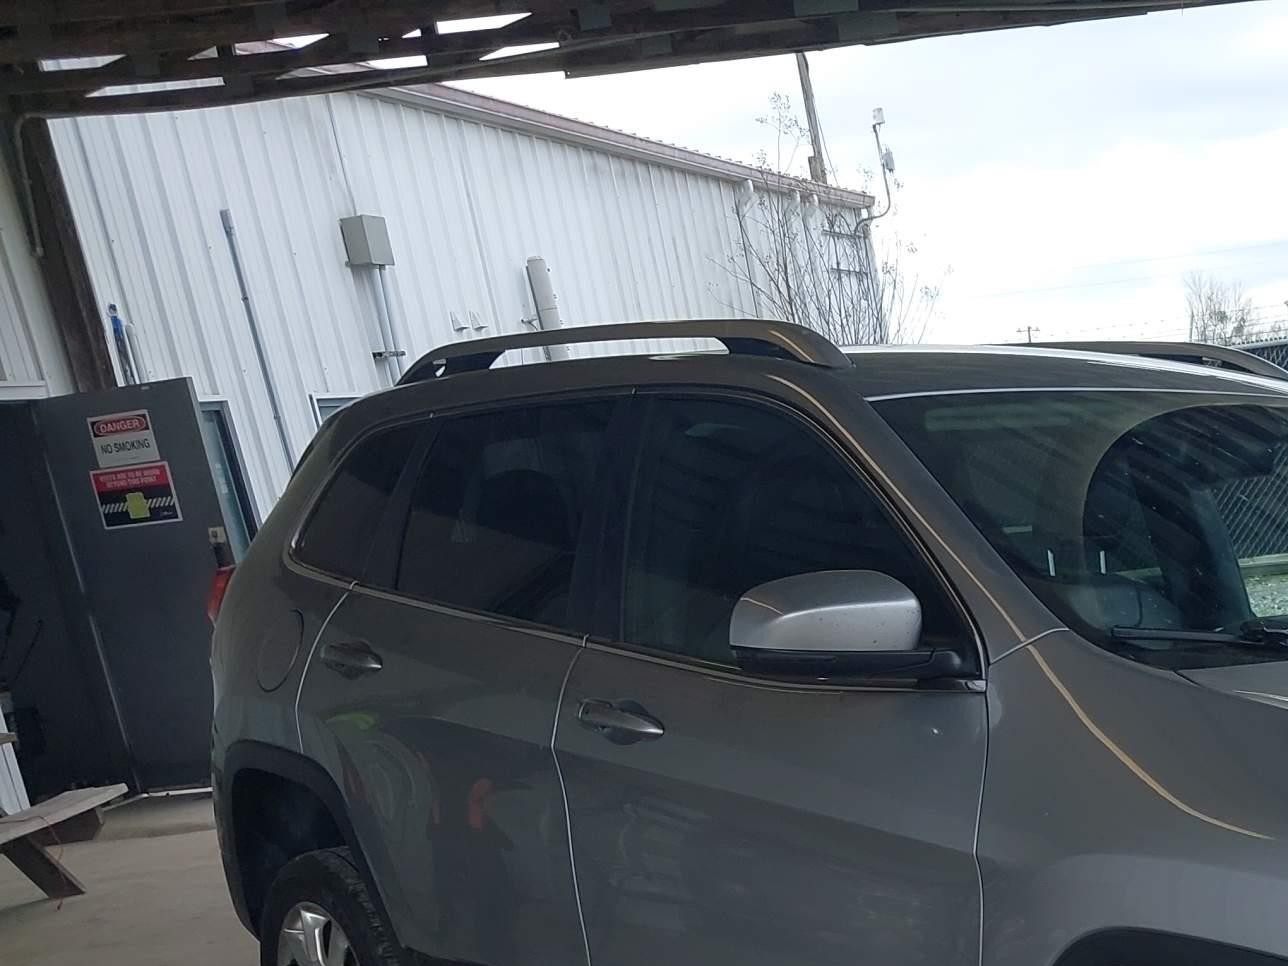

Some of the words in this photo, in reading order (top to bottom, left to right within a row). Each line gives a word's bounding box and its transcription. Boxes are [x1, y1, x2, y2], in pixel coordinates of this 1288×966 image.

[100, 419, 141, 433] DANGER
[100, 444, 113, 454] NO
[113, 438, 151, 453] SMOKING
